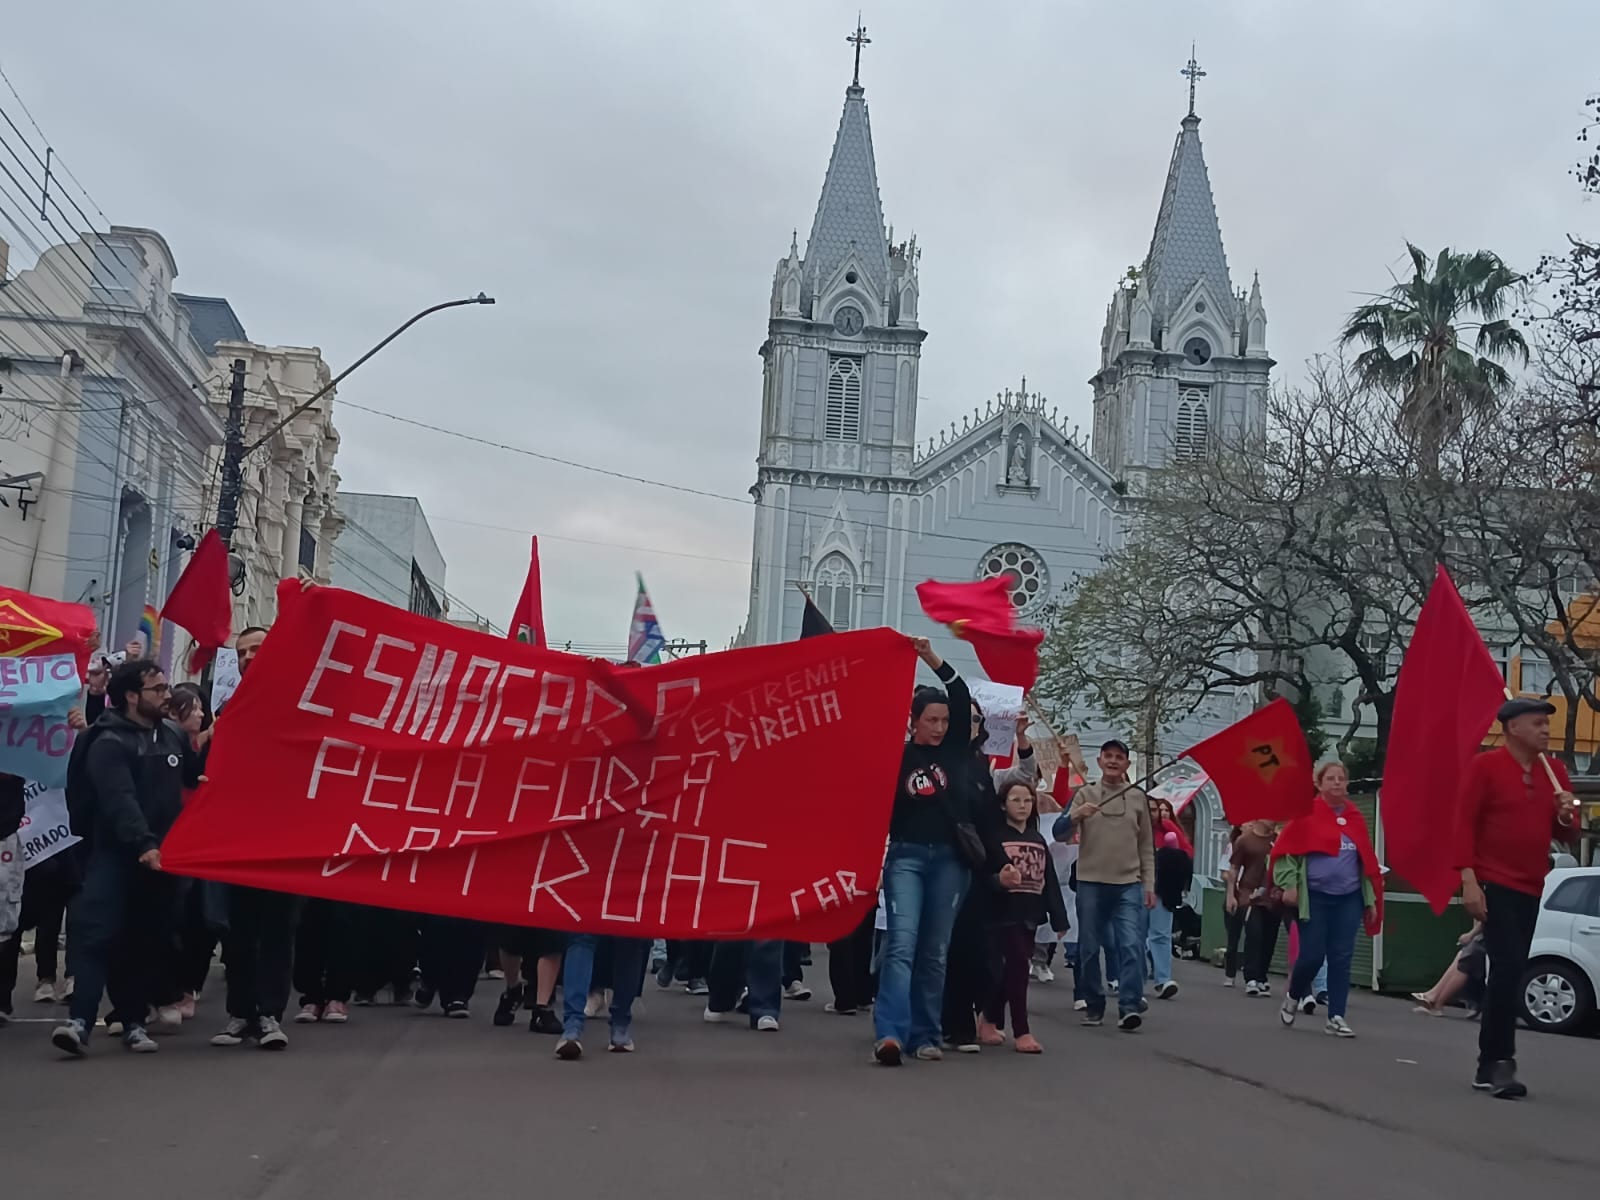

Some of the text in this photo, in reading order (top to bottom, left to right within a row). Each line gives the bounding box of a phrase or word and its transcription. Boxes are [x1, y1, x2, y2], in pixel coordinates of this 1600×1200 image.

[0, 656, 76, 684] EITO
[297, 619, 627, 747] ESMAGAR
[723, 689, 843, 762] DIREITA
[306, 735, 721, 829] PELA FORÇA
[1251, 743, 1280, 769] PT
[24, 781, 48, 801] RTO
[23, 824, 69, 861] ERRADO
[528, 826, 767, 935] RUAS
